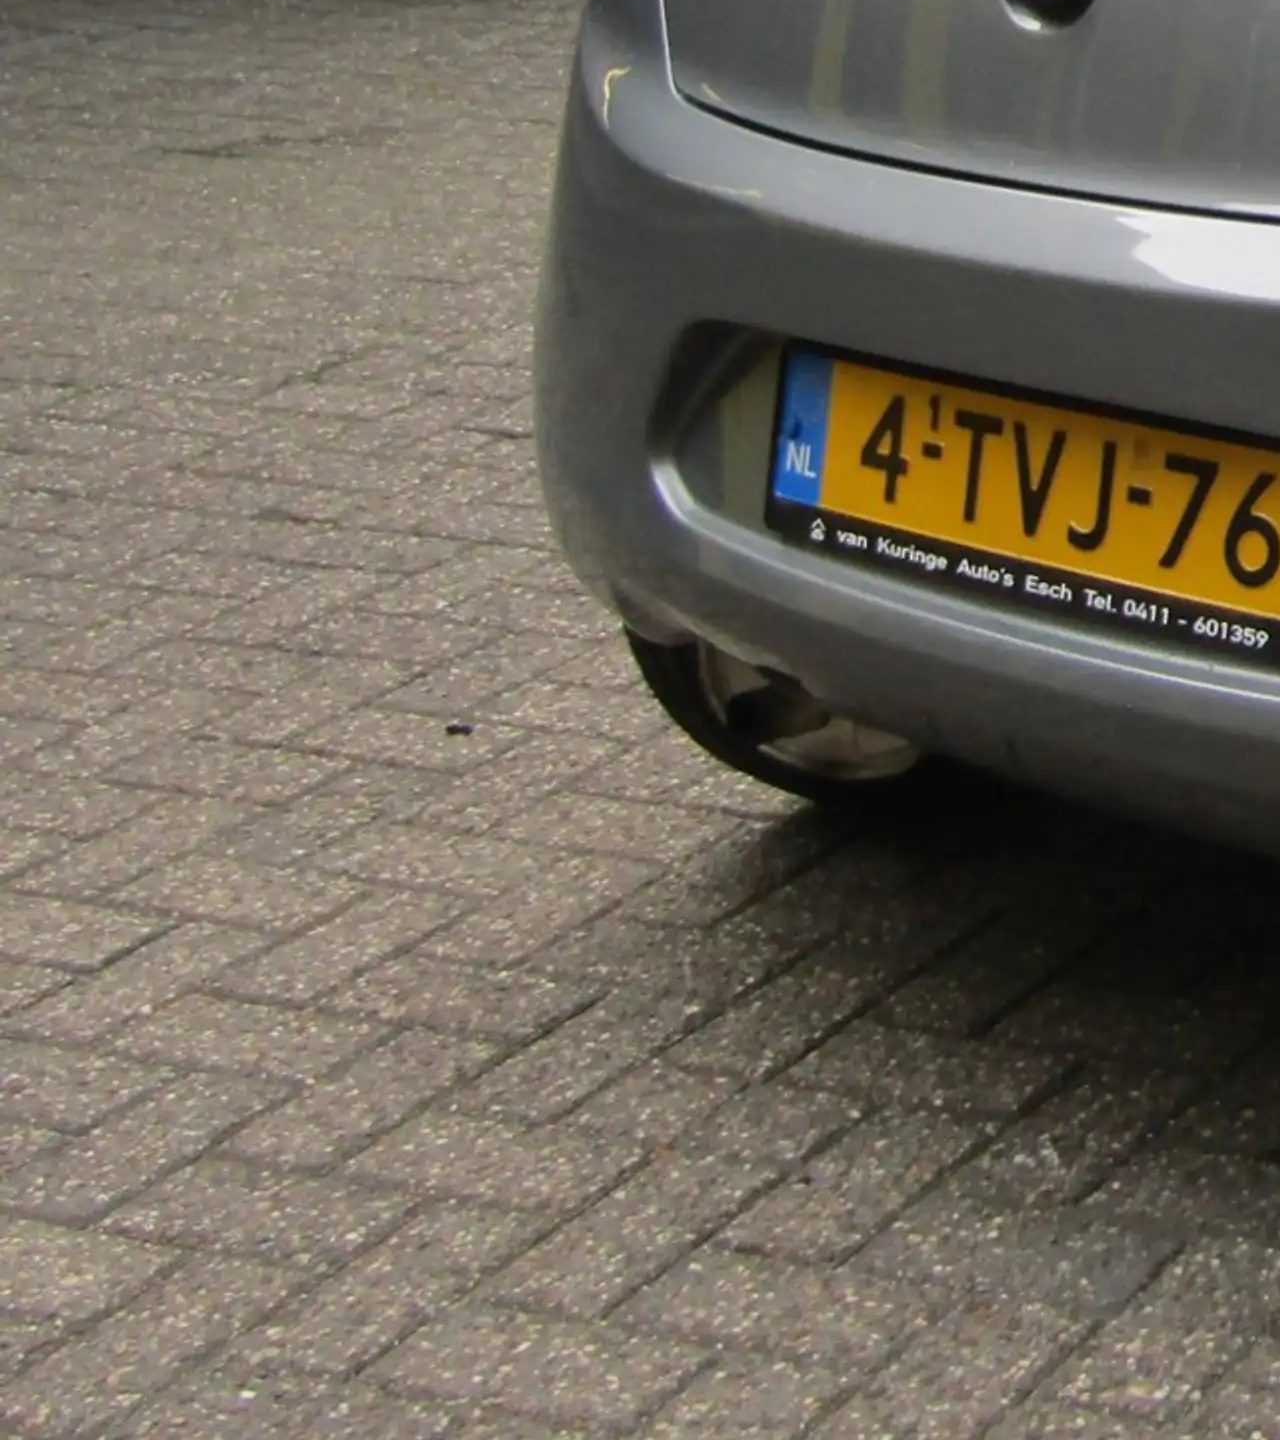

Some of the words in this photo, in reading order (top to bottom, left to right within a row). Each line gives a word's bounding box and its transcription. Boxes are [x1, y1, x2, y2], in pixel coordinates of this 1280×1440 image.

[784, 440, 818, 479] NL
[835, 528, 868, 550] van
[875, 536, 949, 571] Kuringe
[956, 557, 1015, 588] Auto's
[1024, 574, 1074, 603] Esch
[1083, 588, 1118, 614] Tel.
[1122, 599, 1170, 626] 0411
[1192, 615, 1270, 650] 601359
